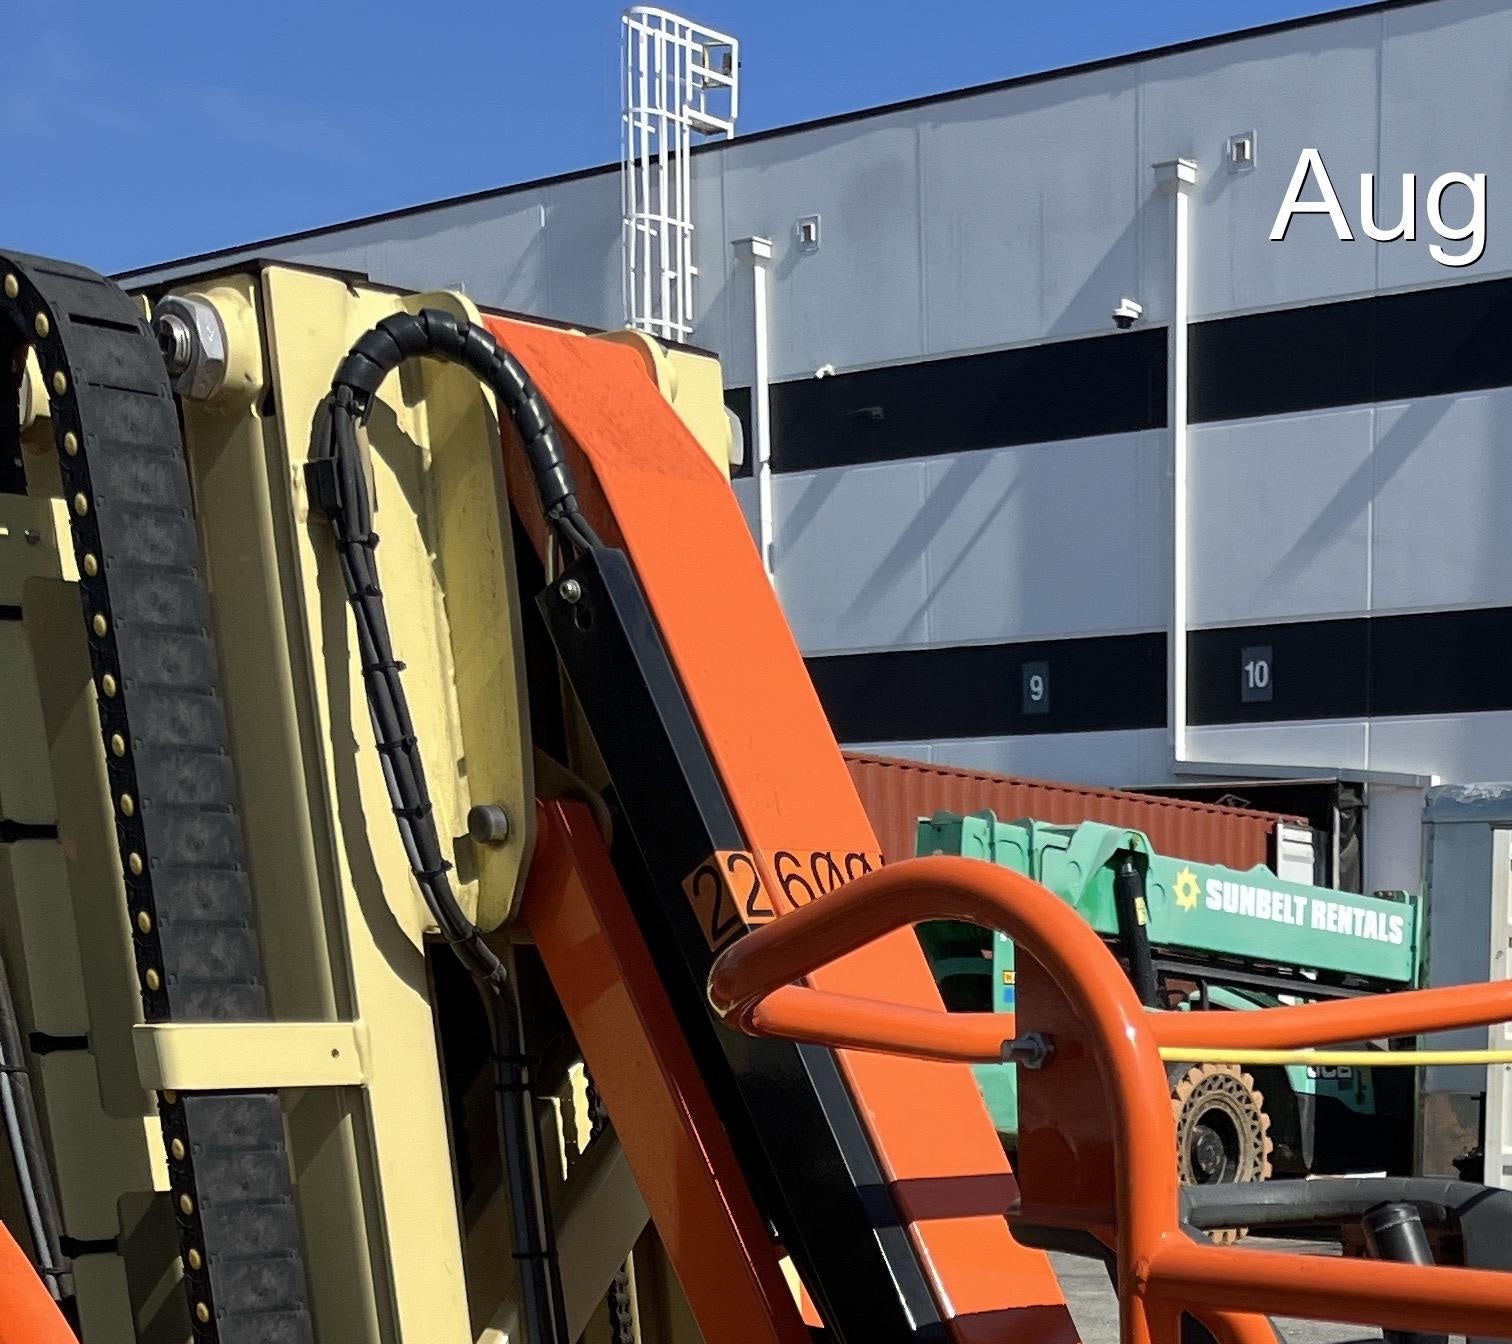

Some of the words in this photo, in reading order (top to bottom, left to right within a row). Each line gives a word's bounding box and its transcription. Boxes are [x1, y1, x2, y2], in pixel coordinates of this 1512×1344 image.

[1029, 674, 1044, 701] 9
[1244, 660, 1269, 688] 10
[1205, 878, 1307, 926] SUNBELT
[1311, 899, 1404, 945] RENTALS
